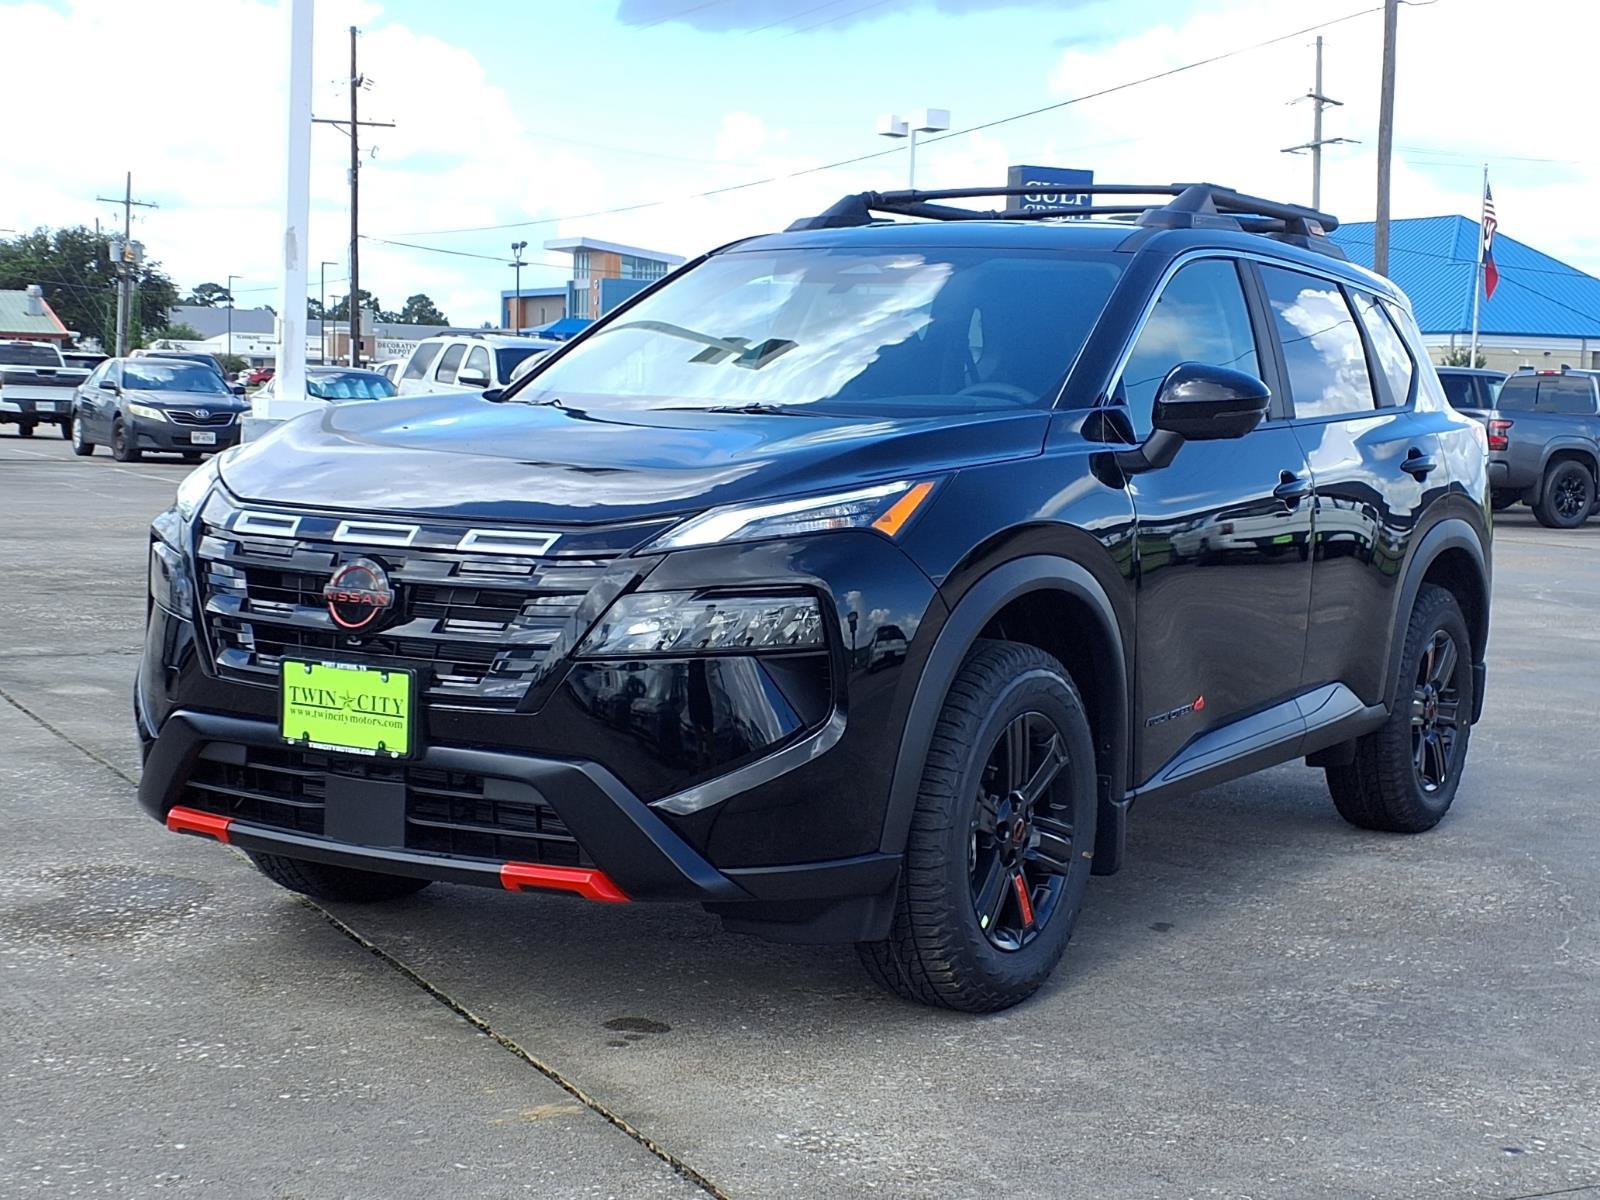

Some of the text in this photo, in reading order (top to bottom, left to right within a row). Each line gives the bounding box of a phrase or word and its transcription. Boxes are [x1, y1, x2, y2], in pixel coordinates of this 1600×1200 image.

[1024, 180, 1088, 205] GULF
[326, 590, 389, 606] NISSAN
[289, 685, 404, 715] TWIN CITY
[289, 706, 403, 729] www.twincitymotors.com
